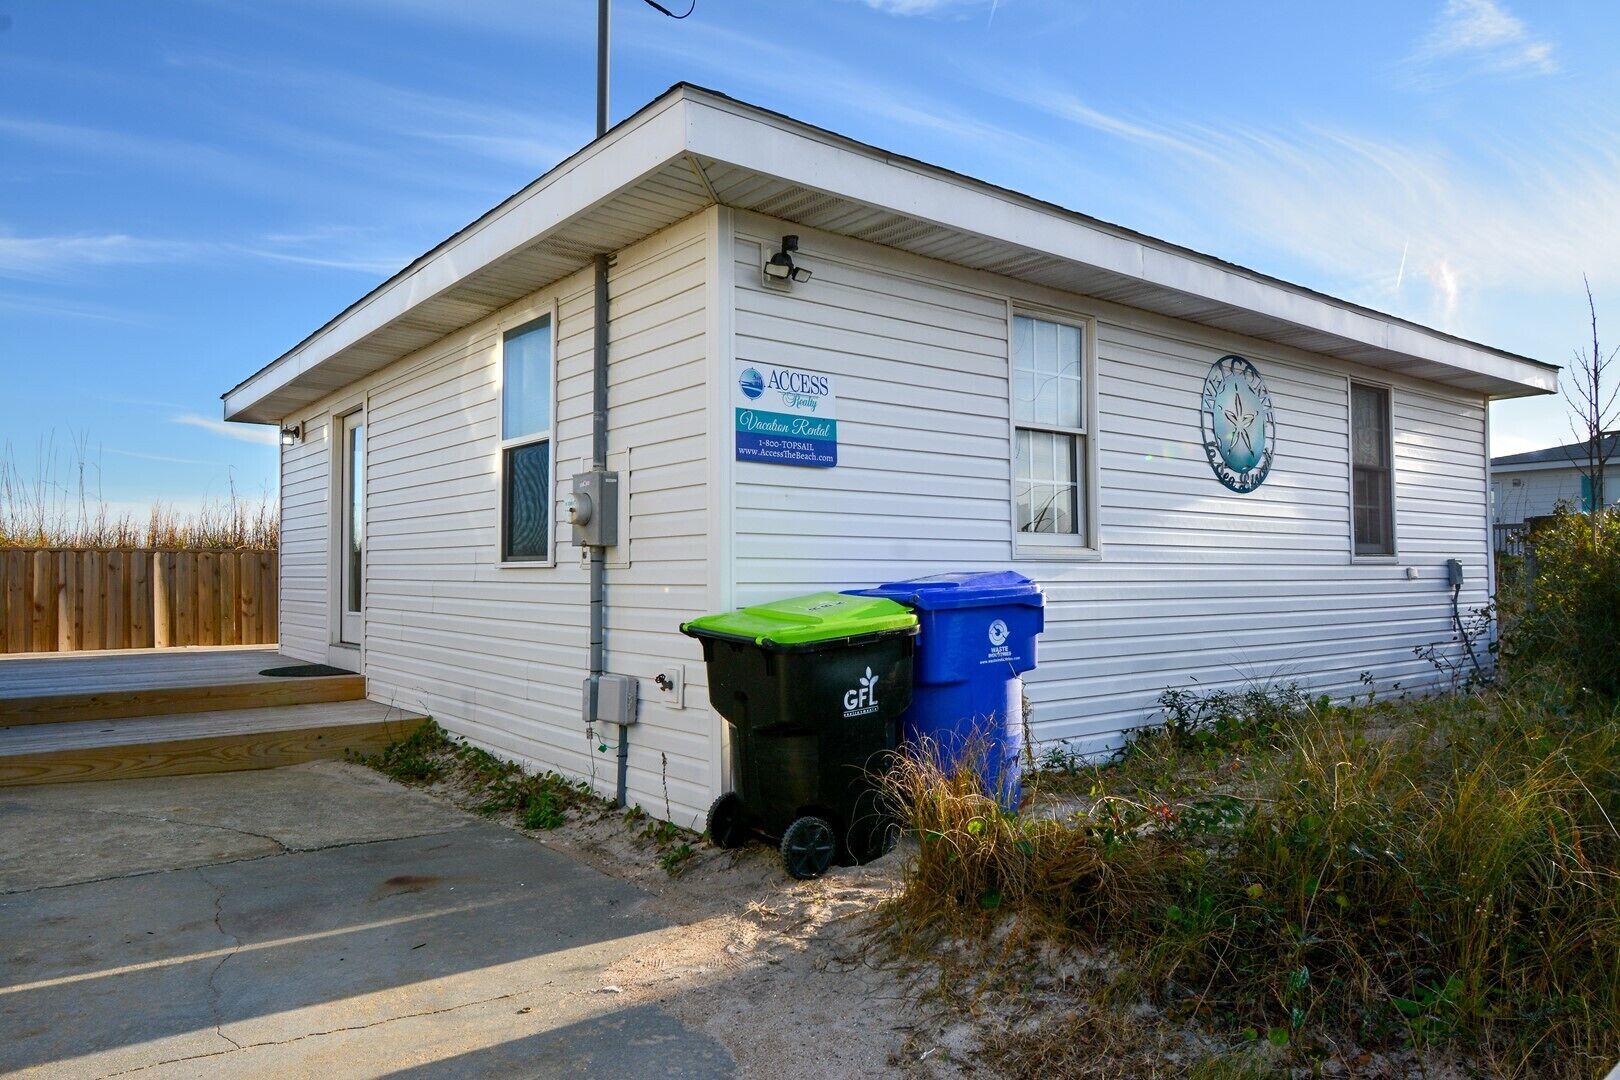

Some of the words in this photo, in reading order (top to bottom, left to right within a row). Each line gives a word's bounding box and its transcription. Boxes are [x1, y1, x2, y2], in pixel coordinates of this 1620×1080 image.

[768, 369, 829, 396] ACCESS
[782, 391, 817, 412] Realty
[740, 410, 789, 432] Vacation
[792, 418, 830, 437] Rental
[738, 447, 834, 462] www.AccessTheBeach.com
[759, 439, 815, 451] 1-800-TOPSAIL
[844, 674, 879, 710] GFL
